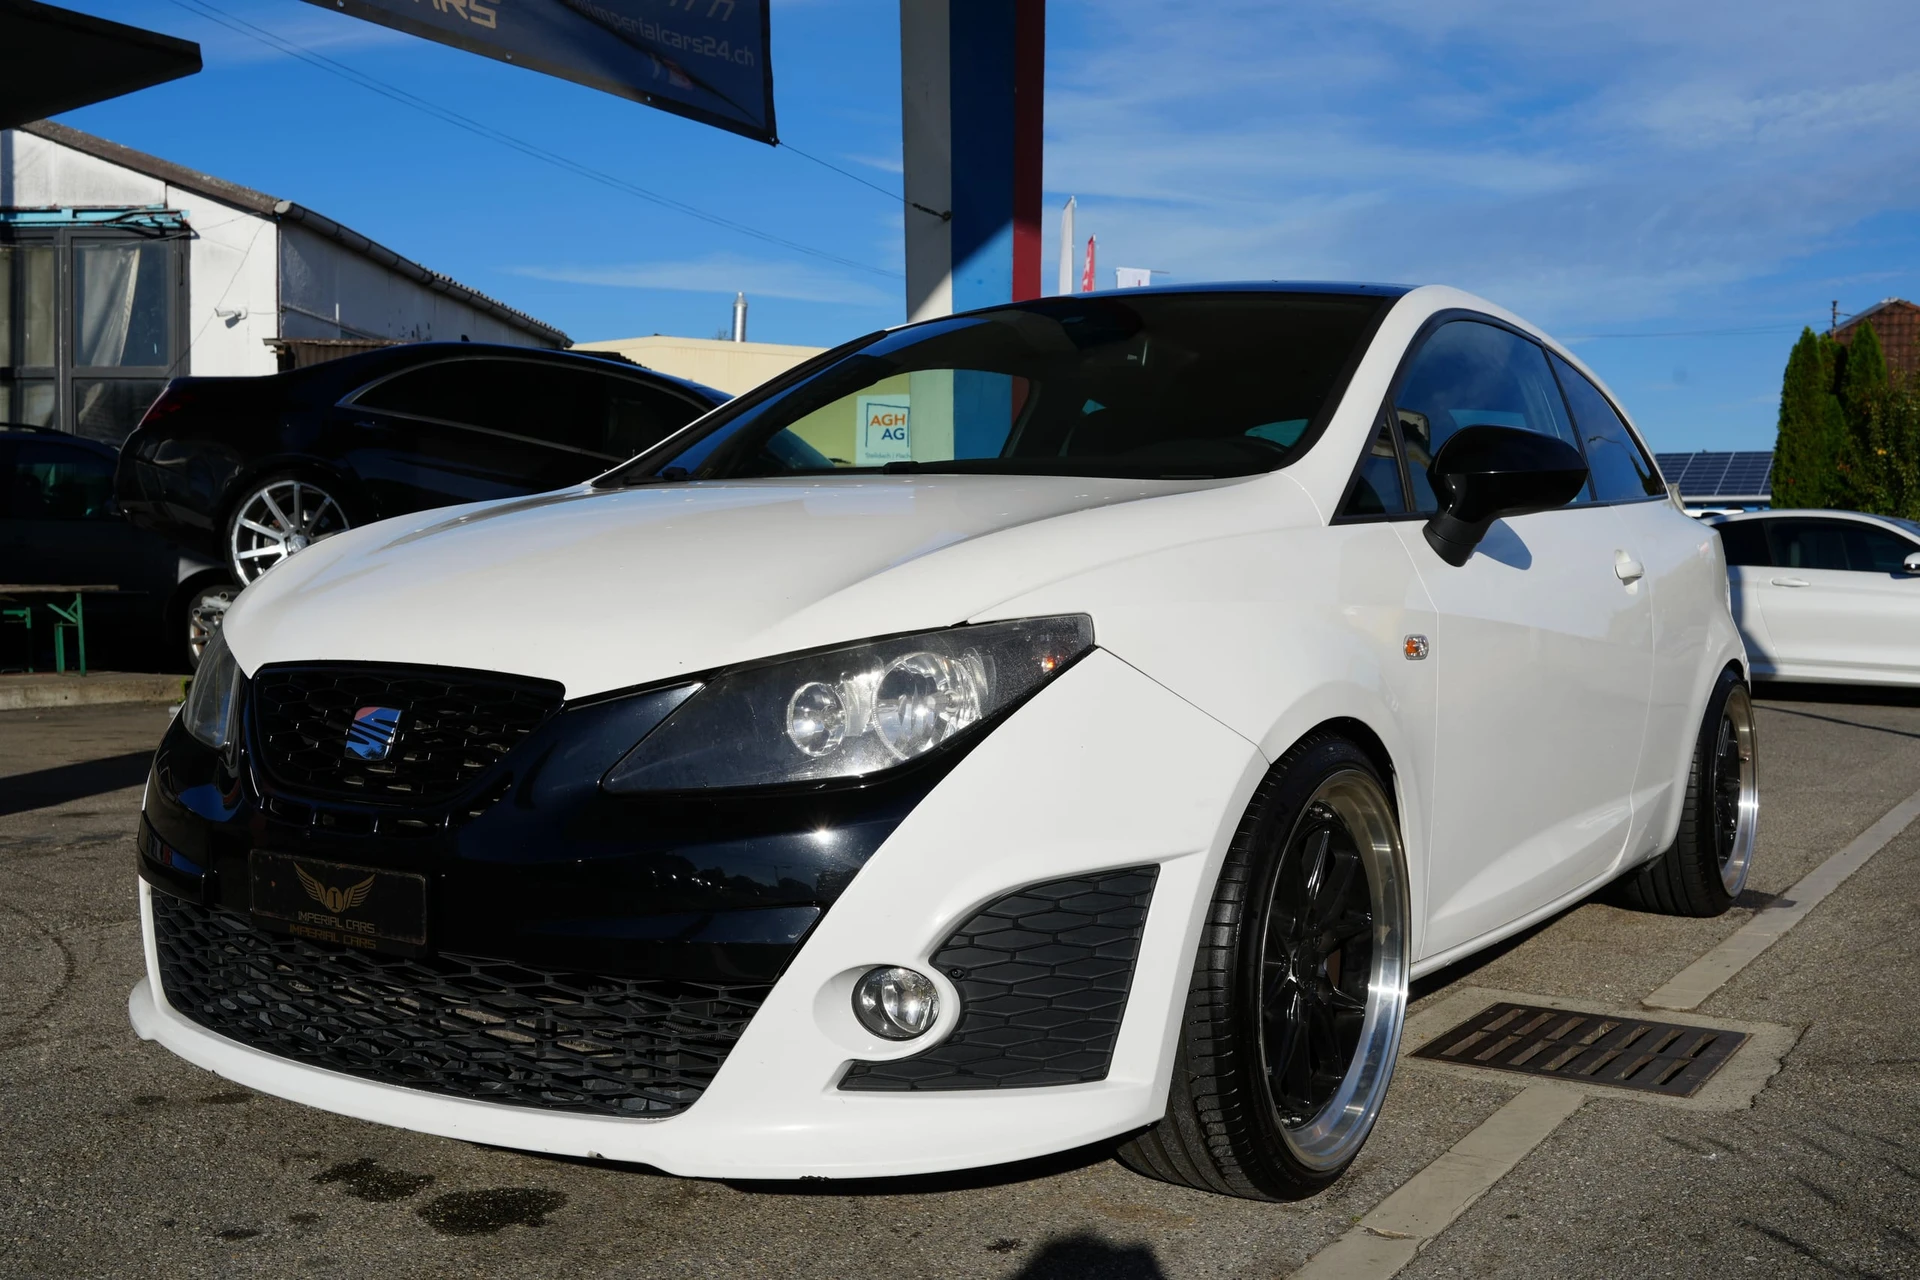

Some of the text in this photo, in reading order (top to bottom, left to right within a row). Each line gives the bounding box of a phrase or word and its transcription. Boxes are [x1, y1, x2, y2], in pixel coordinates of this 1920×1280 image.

[870, 413, 906, 427] AGH
[881, 427, 905, 441] AG
[298, 910, 376, 934] IMPERIAL CARS
[289, 924, 376, 950] IMPERIAL CARS
